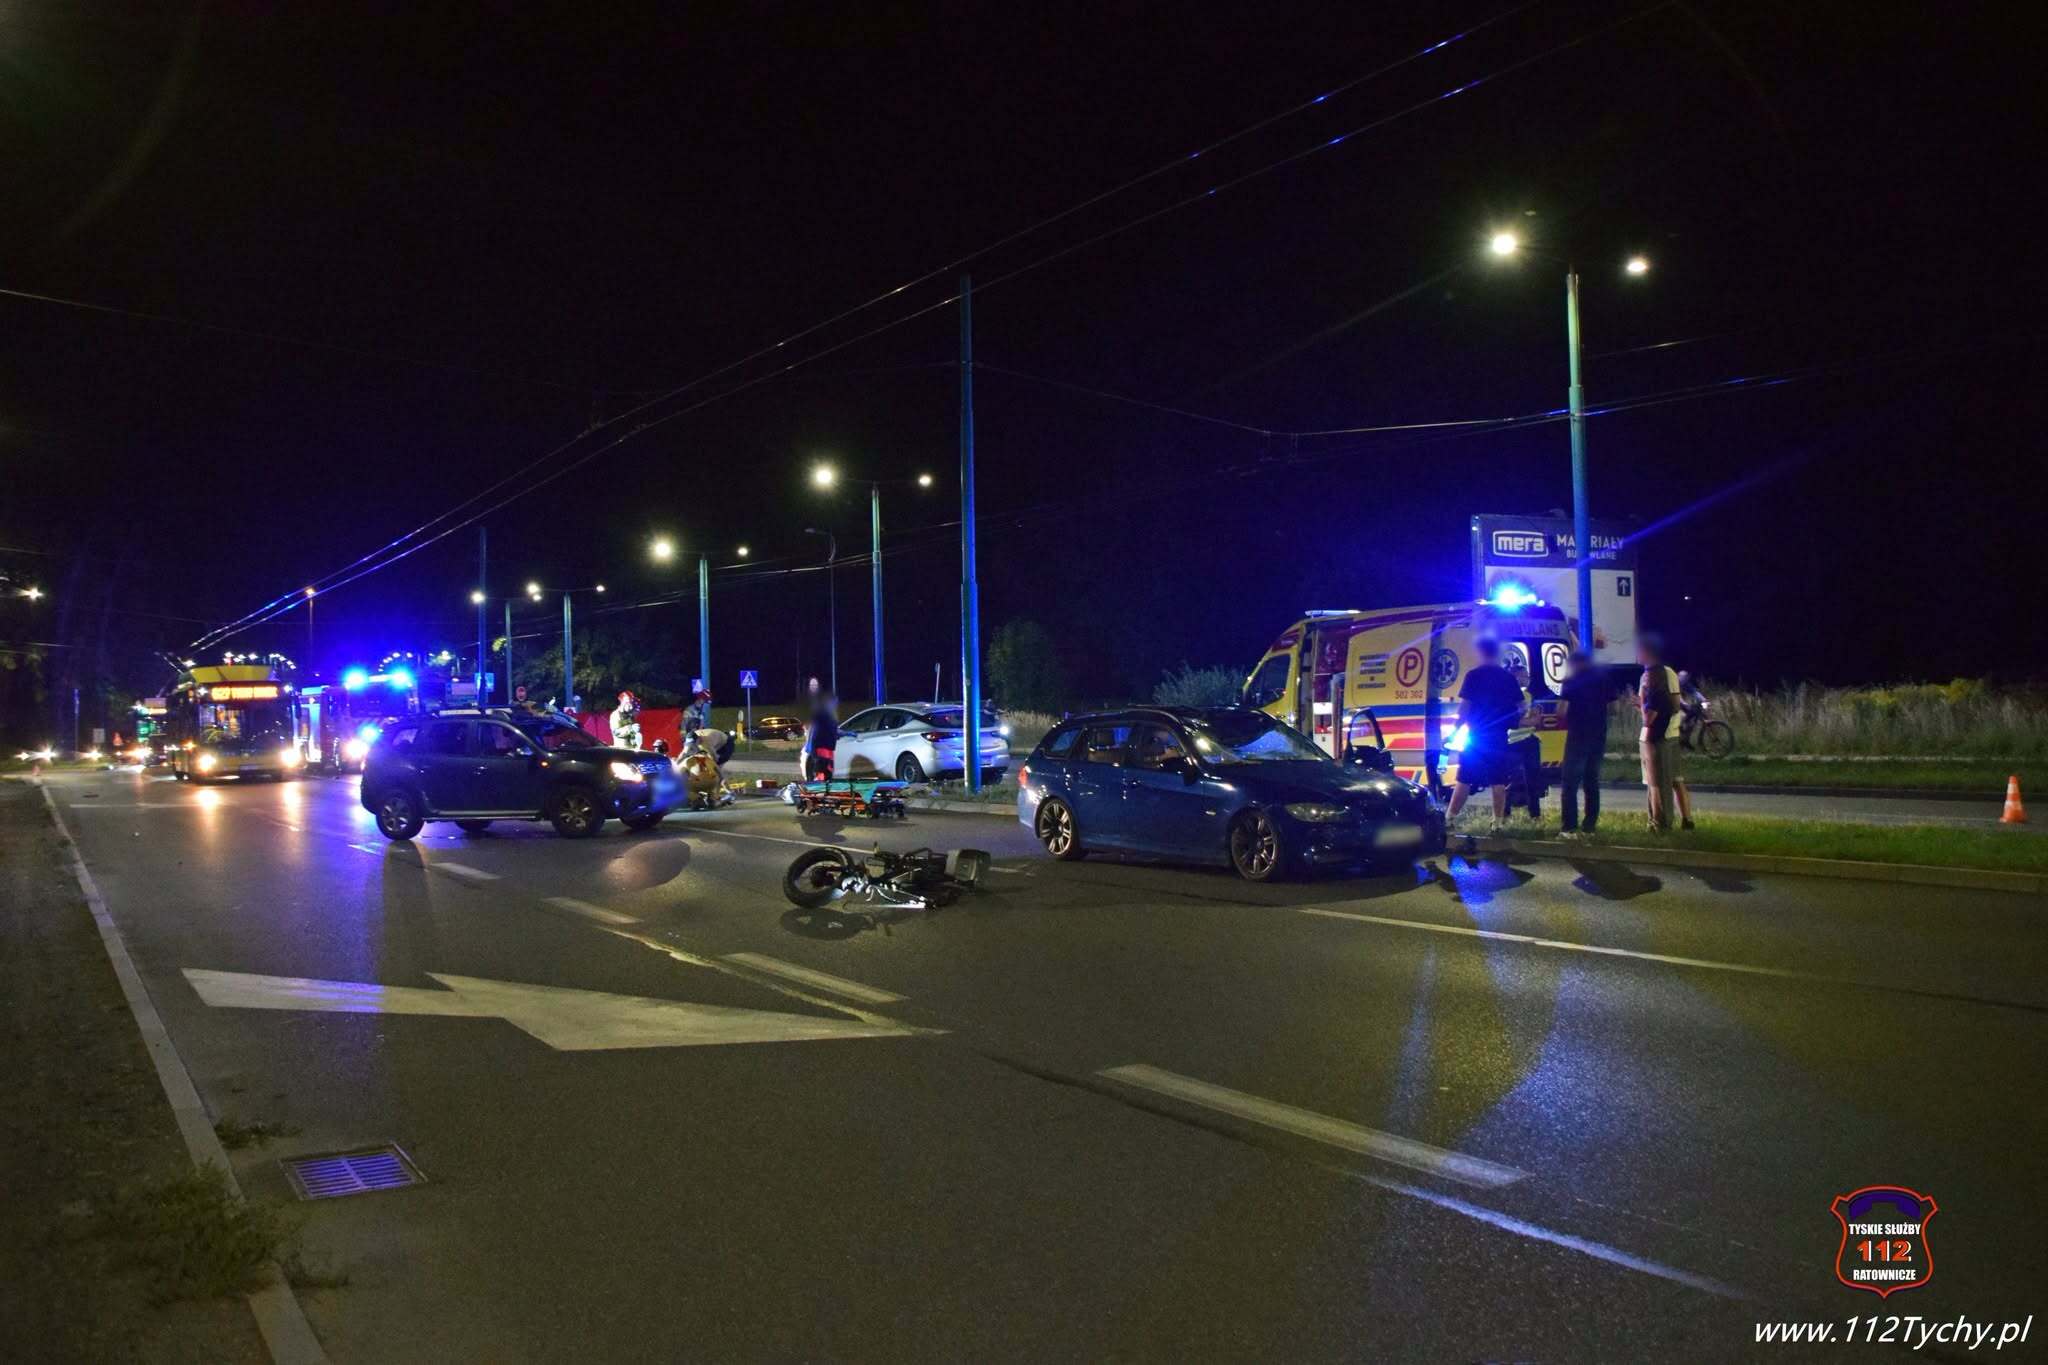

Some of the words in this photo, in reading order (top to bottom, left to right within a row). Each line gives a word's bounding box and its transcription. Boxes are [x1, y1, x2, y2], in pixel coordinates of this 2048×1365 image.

[1497, 536, 1545, 552] mera
[1556, 533, 1624, 550] MARIAŁY
[1566, 549, 1617, 560] BUWLANE
[1403, 655, 1418, 680] P
[1551, 652, 1564, 677] P
